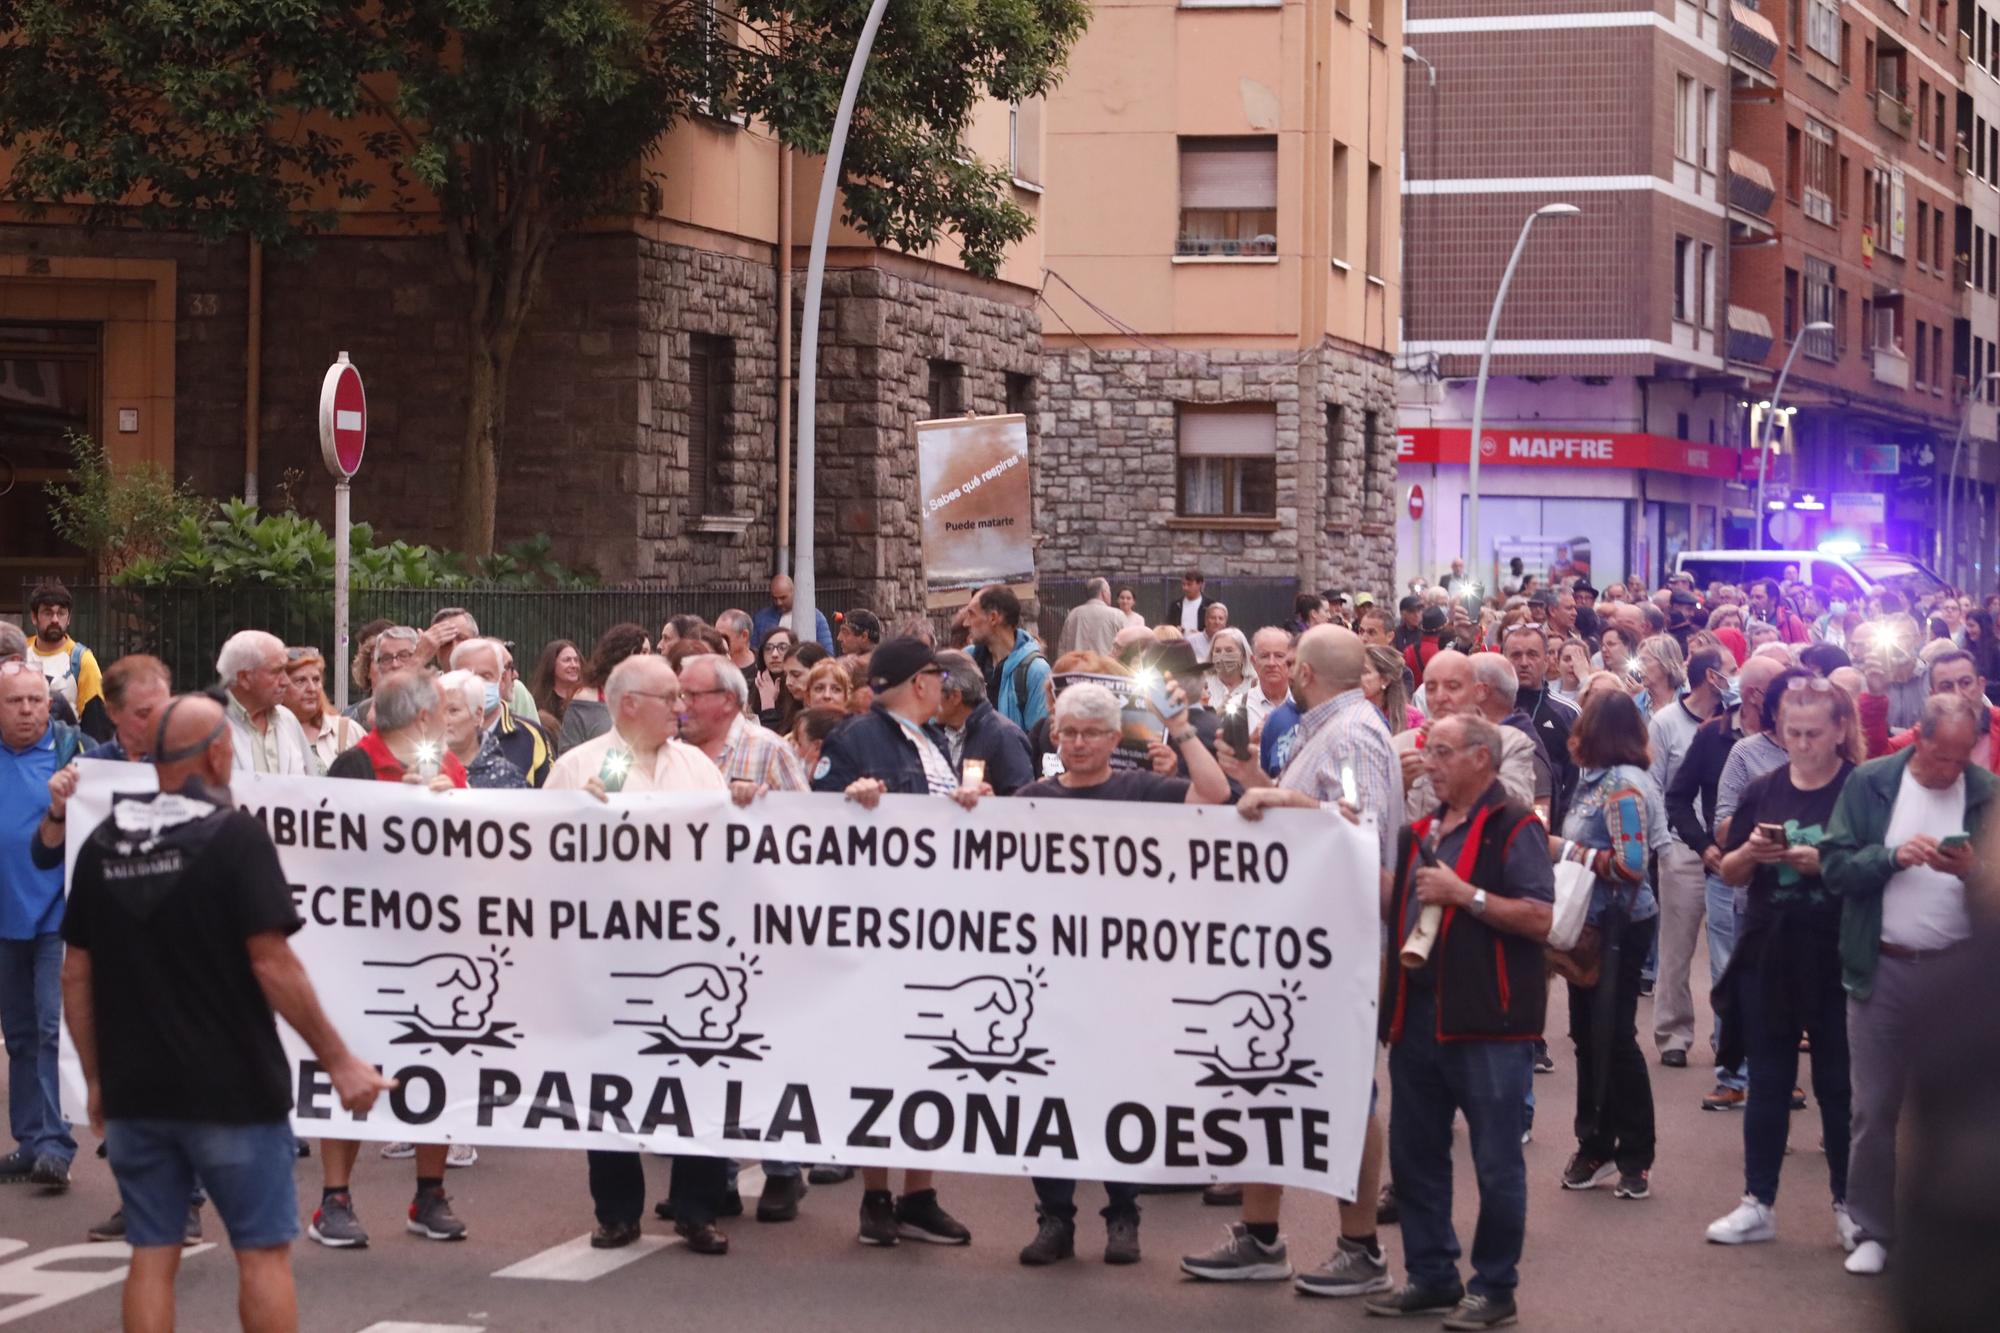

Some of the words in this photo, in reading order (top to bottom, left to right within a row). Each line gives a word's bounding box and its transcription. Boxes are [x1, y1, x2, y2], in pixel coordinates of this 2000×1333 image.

[190, 294, 218, 316] 33
[1508, 437, 1614, 460] MAPFRE
[929, 487, 962, 511] Sabes
[961, 475, 981, 494] qué
[981, 454, 1019, 483] respiras
[945, 519, 976, 532] Puede
[978, 516, 1015, 529] matarte
[382, 814, 533, 862] SOMOS
[548, 808, 672, 862] GIJÓN
[687, 822, 709, 861] Y
[726, 822, 937, 869] PAGAMOS
[953, 829, 1177, 884] IMPUESTOS,
[1188, 839, 1290, 884] PERO
[478, 896, 534, 938] EN
[549, 900, 738, 949] PLANES,
[753, 903, 1037, 955] INVERSIONES
[1052, 914, 1089, 958] NI
[1101, 917, 1333, 970] PROYECTOS
[297, 1059, 447, 1125] EO
[477, 1068, 694, 1140] PARA
[722, 1080, 821, 1145] LA
[846, 1086, 1079, 1160] ZONA
[1105, 1101, 1331, 1174] OESTE
